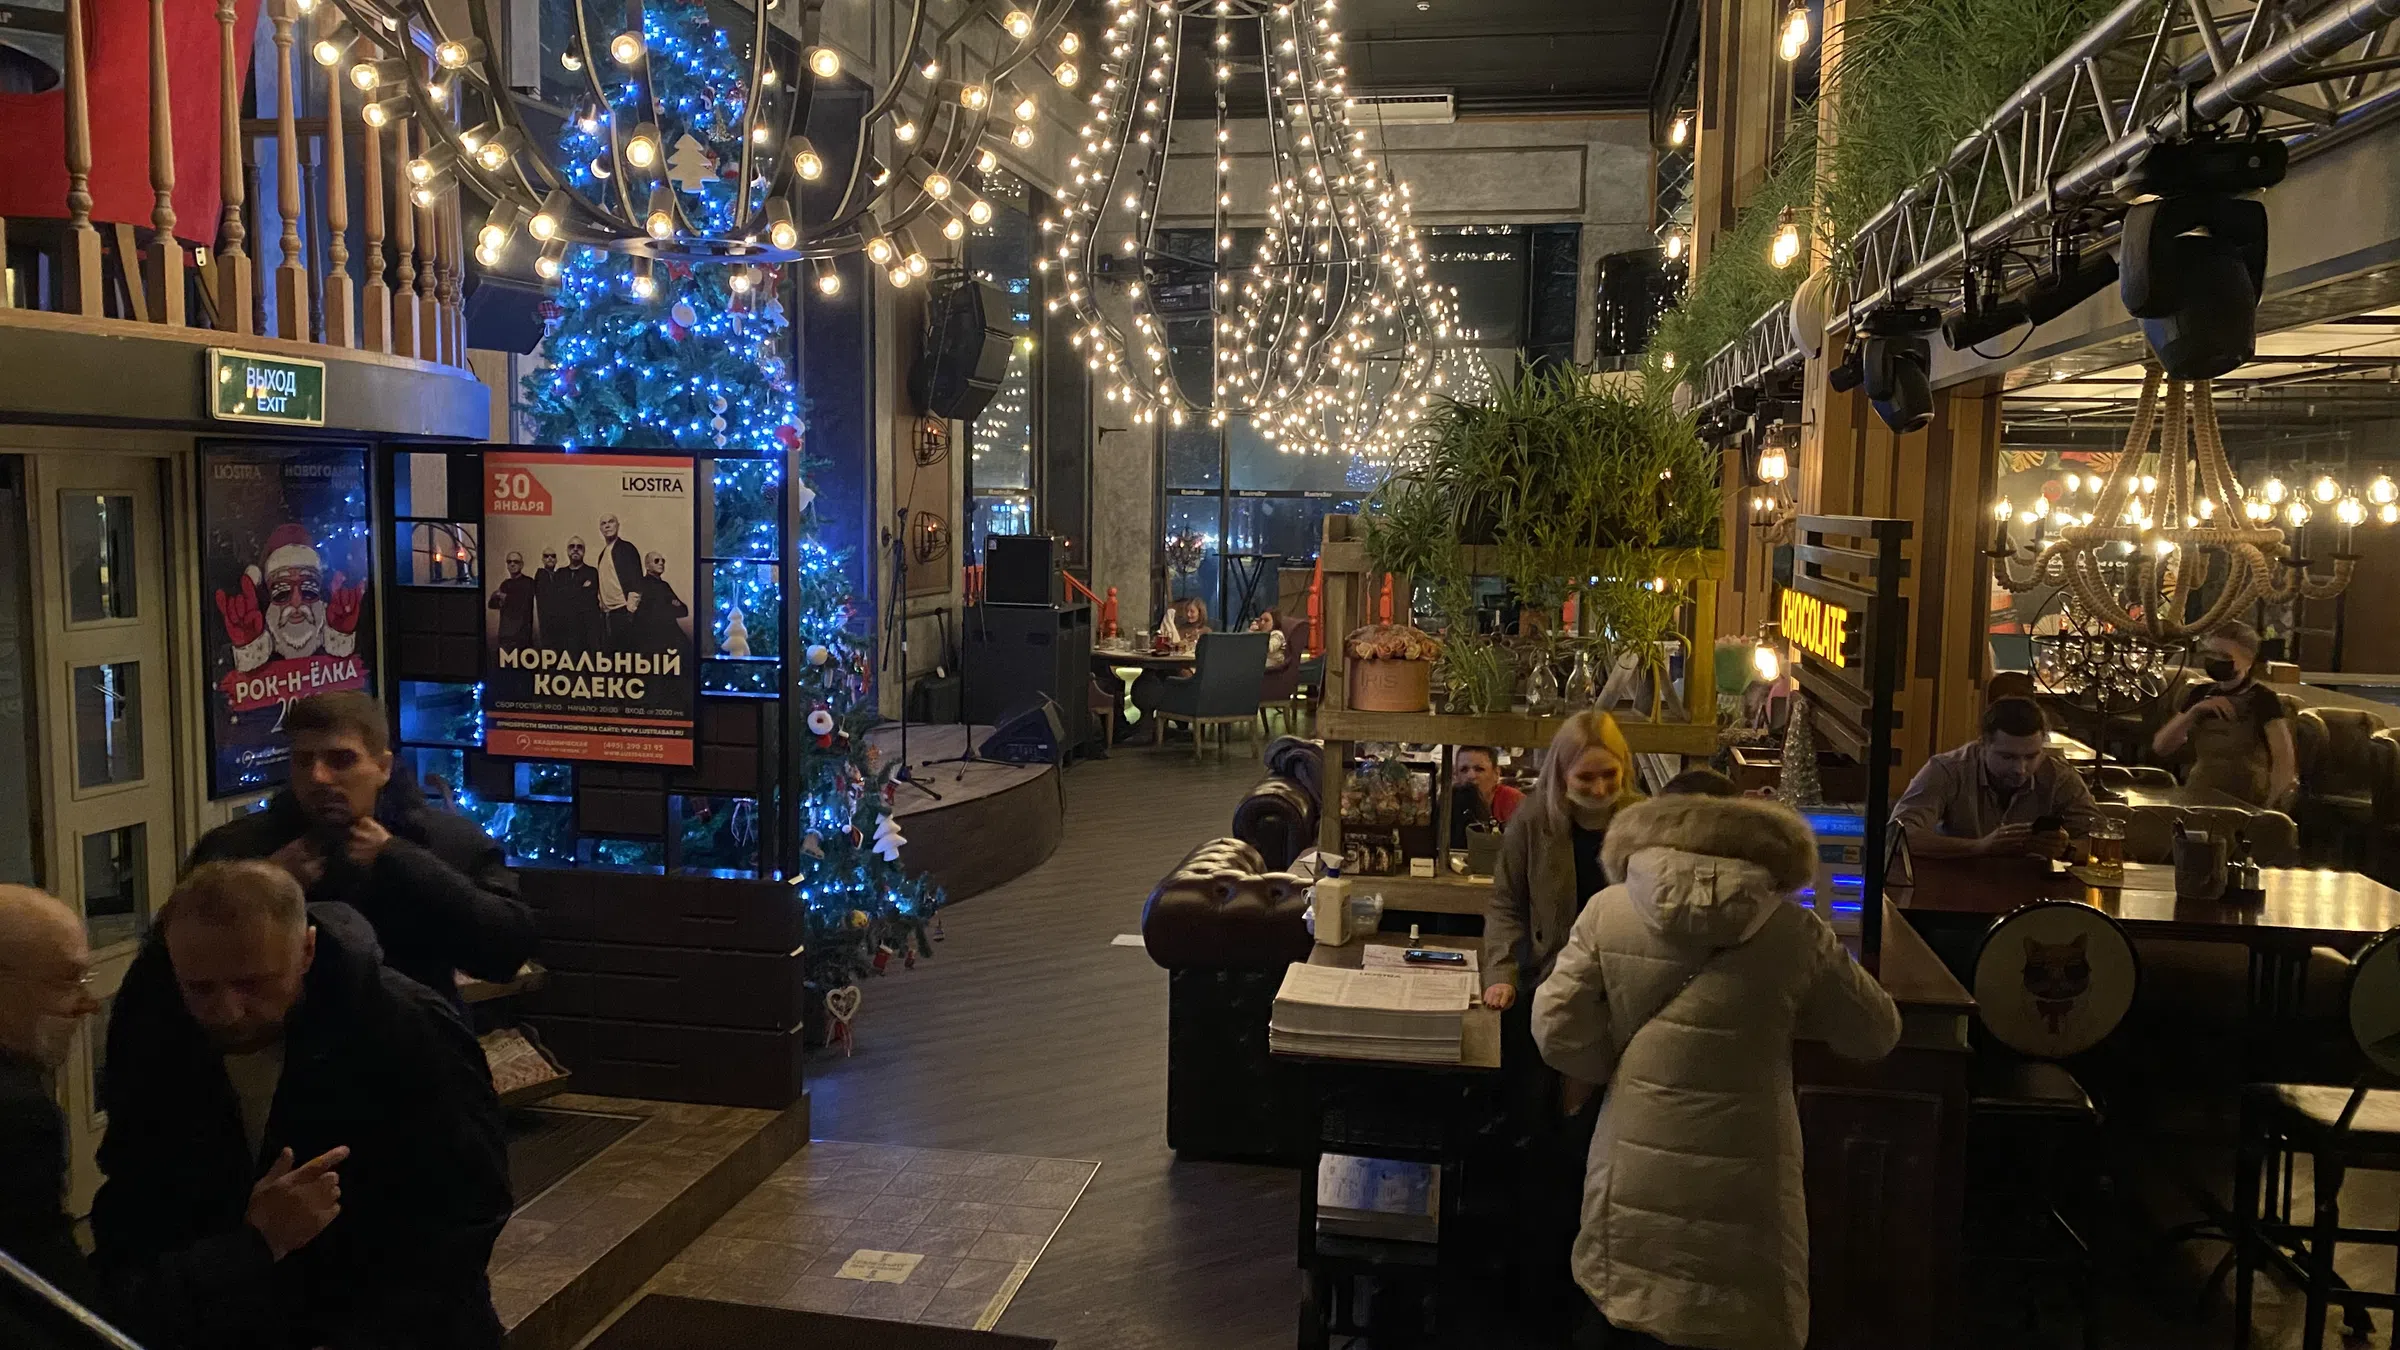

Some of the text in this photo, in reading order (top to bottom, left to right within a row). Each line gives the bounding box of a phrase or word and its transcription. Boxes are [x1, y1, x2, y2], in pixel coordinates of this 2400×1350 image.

[246, 366, 297, 397] ВЫХОД
[257, 396, 288, 412] EXIT
[494, 473, 530, 499] 30
[494, 500, 544, 512] ЯНВАРЯ
[1781, 588, 1847, 668] CHOCOLATE
[499, 647, 680, 676] МОРАЛЬНЫЙ
[235, 660, 358, 704] РОК-Н-ЁЛКА
[534, 673, 645, 699] КОДЕКС
[655, 708, 673, 716] 2000
